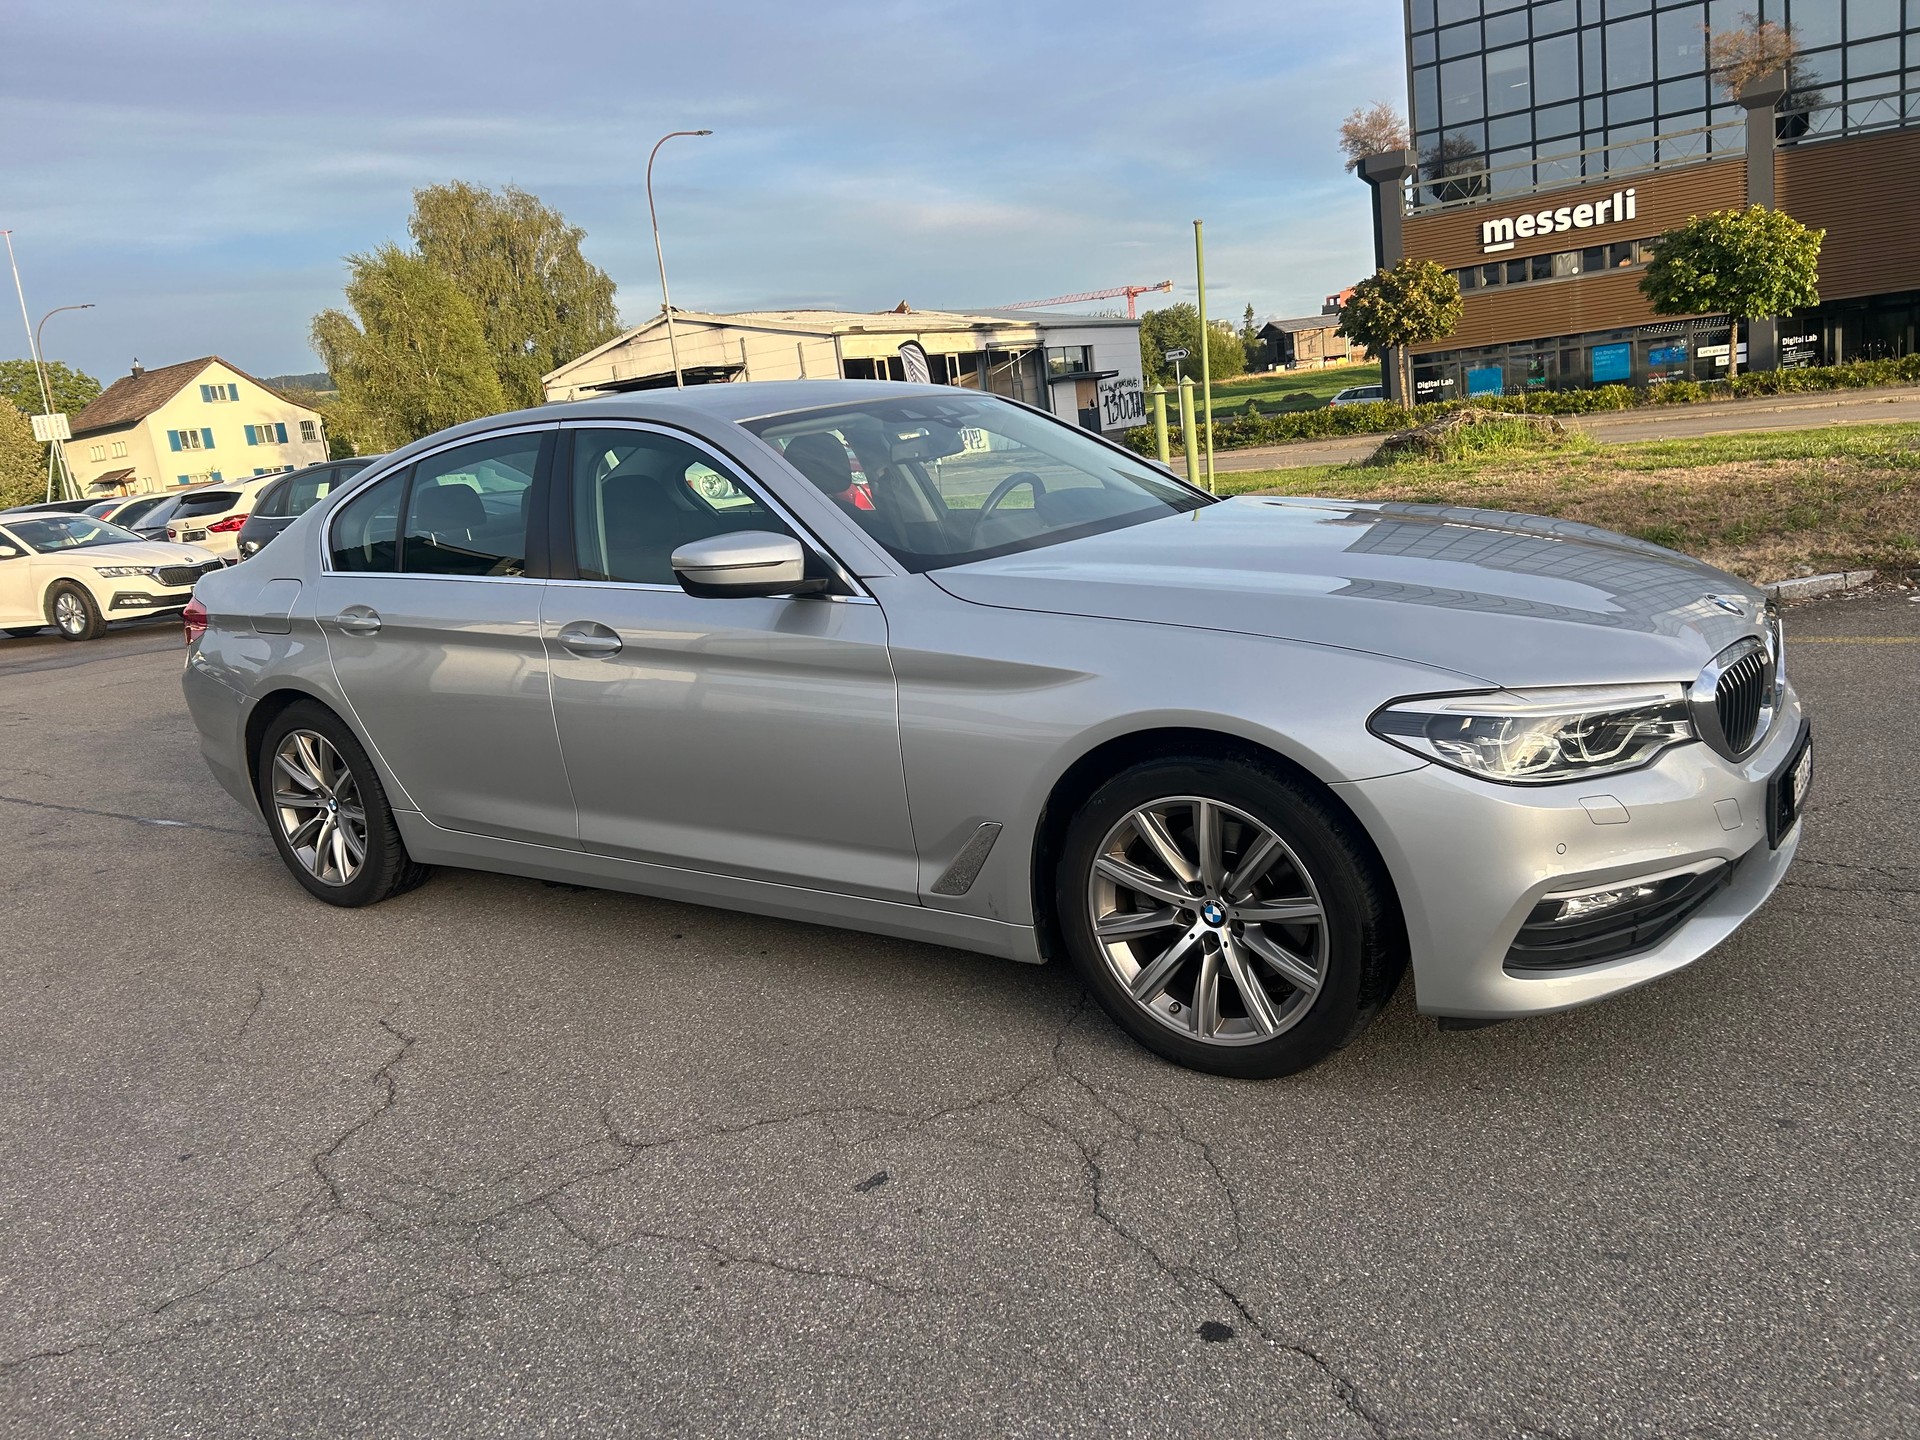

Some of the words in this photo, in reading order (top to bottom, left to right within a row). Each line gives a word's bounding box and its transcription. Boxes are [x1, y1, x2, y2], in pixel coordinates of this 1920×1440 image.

[1482, 188, 1636, 244] messerli
[1782, 336, 1804, 346] Digital
[1805, 334, 1818, 342] Lab
[1417, 380, 1440, 389] Digital
[1440, 378, 1454, 386] Lab
